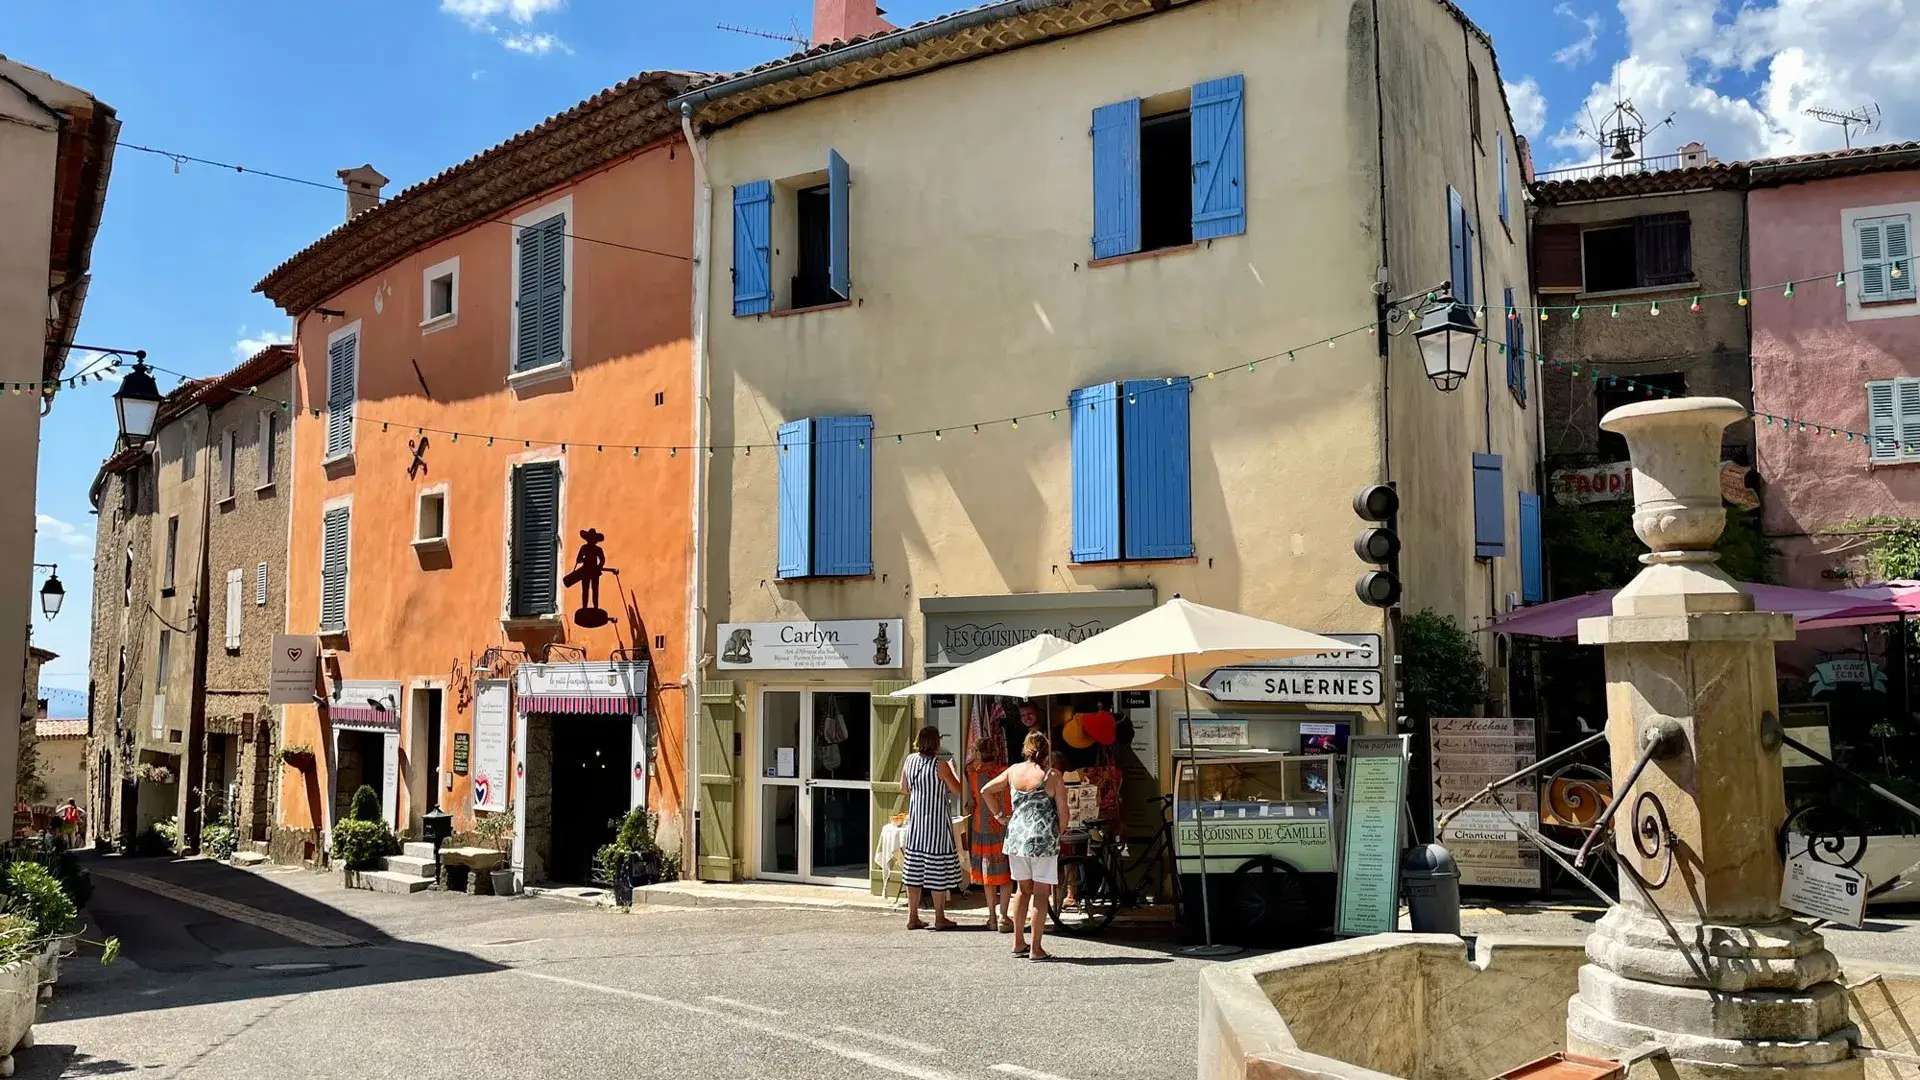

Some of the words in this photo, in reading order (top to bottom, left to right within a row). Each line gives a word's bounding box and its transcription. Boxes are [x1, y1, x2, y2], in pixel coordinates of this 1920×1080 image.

[780, 623, 840, 649] Carlyn
[945, 629, 968, 648] LES
[1220, 680, 1232, 693] 11
[1264, 678, 1374, 696] SALERNES
[1181, 829, 1200, 841] LES
[1203, 827, 1254, 840] COUSINES
[1258, 827, 1273, 839] DE
[1276, 826, 1327, 839] CAMILLE
